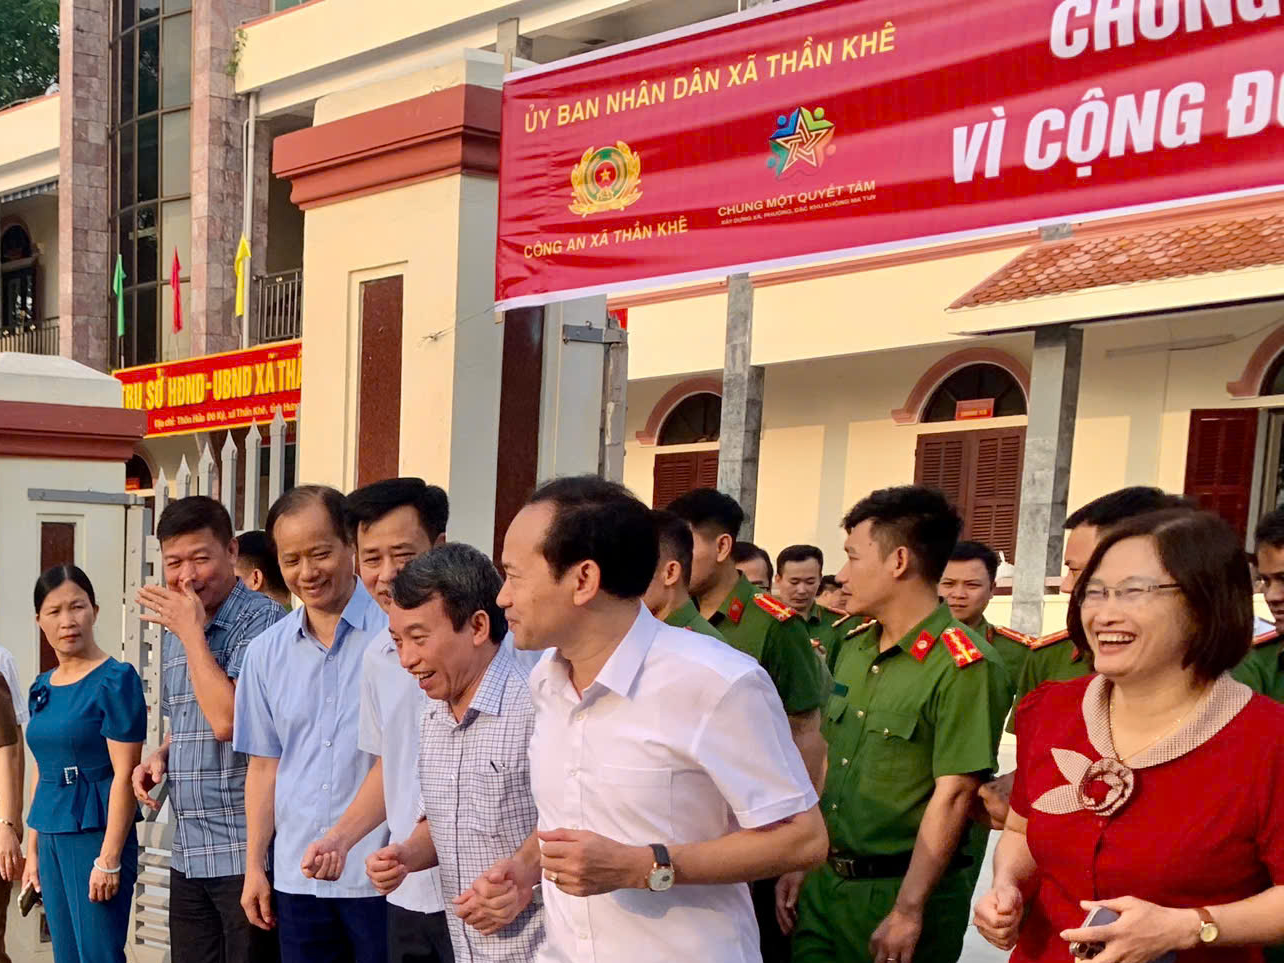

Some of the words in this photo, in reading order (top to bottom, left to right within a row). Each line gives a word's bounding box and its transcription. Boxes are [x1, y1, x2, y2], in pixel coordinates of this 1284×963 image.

[524, 102, 550, 133] ỦY
[556, 98, 600, 127] BAN
[605, 81, 666, 115] NHÂN
[673, 67, 720, 99] DÂN
[727, 54, 758, 88] XÃ
[766, 35, 834, 78] THẦN
[841, 21, 897, 62] KHÊ
[952, 106, 1007, 184] VÌ
[1023, 81, 1206, 178] CỘNG
[717, 200, 764, 217] CHUNG
[766, 193, 796, 209] MỘT
[797, 184, 844, 204] QUYẾT
[847, 180, 876, 195] TÂM
[524, 240, 563, 259] CÔNG
[566, 236, 586, 252] AN
[590, 229, 609, 248] XÃ
[613, 220, 653, 244] THẦN
[657, 214, 689, 237] KHÊ
